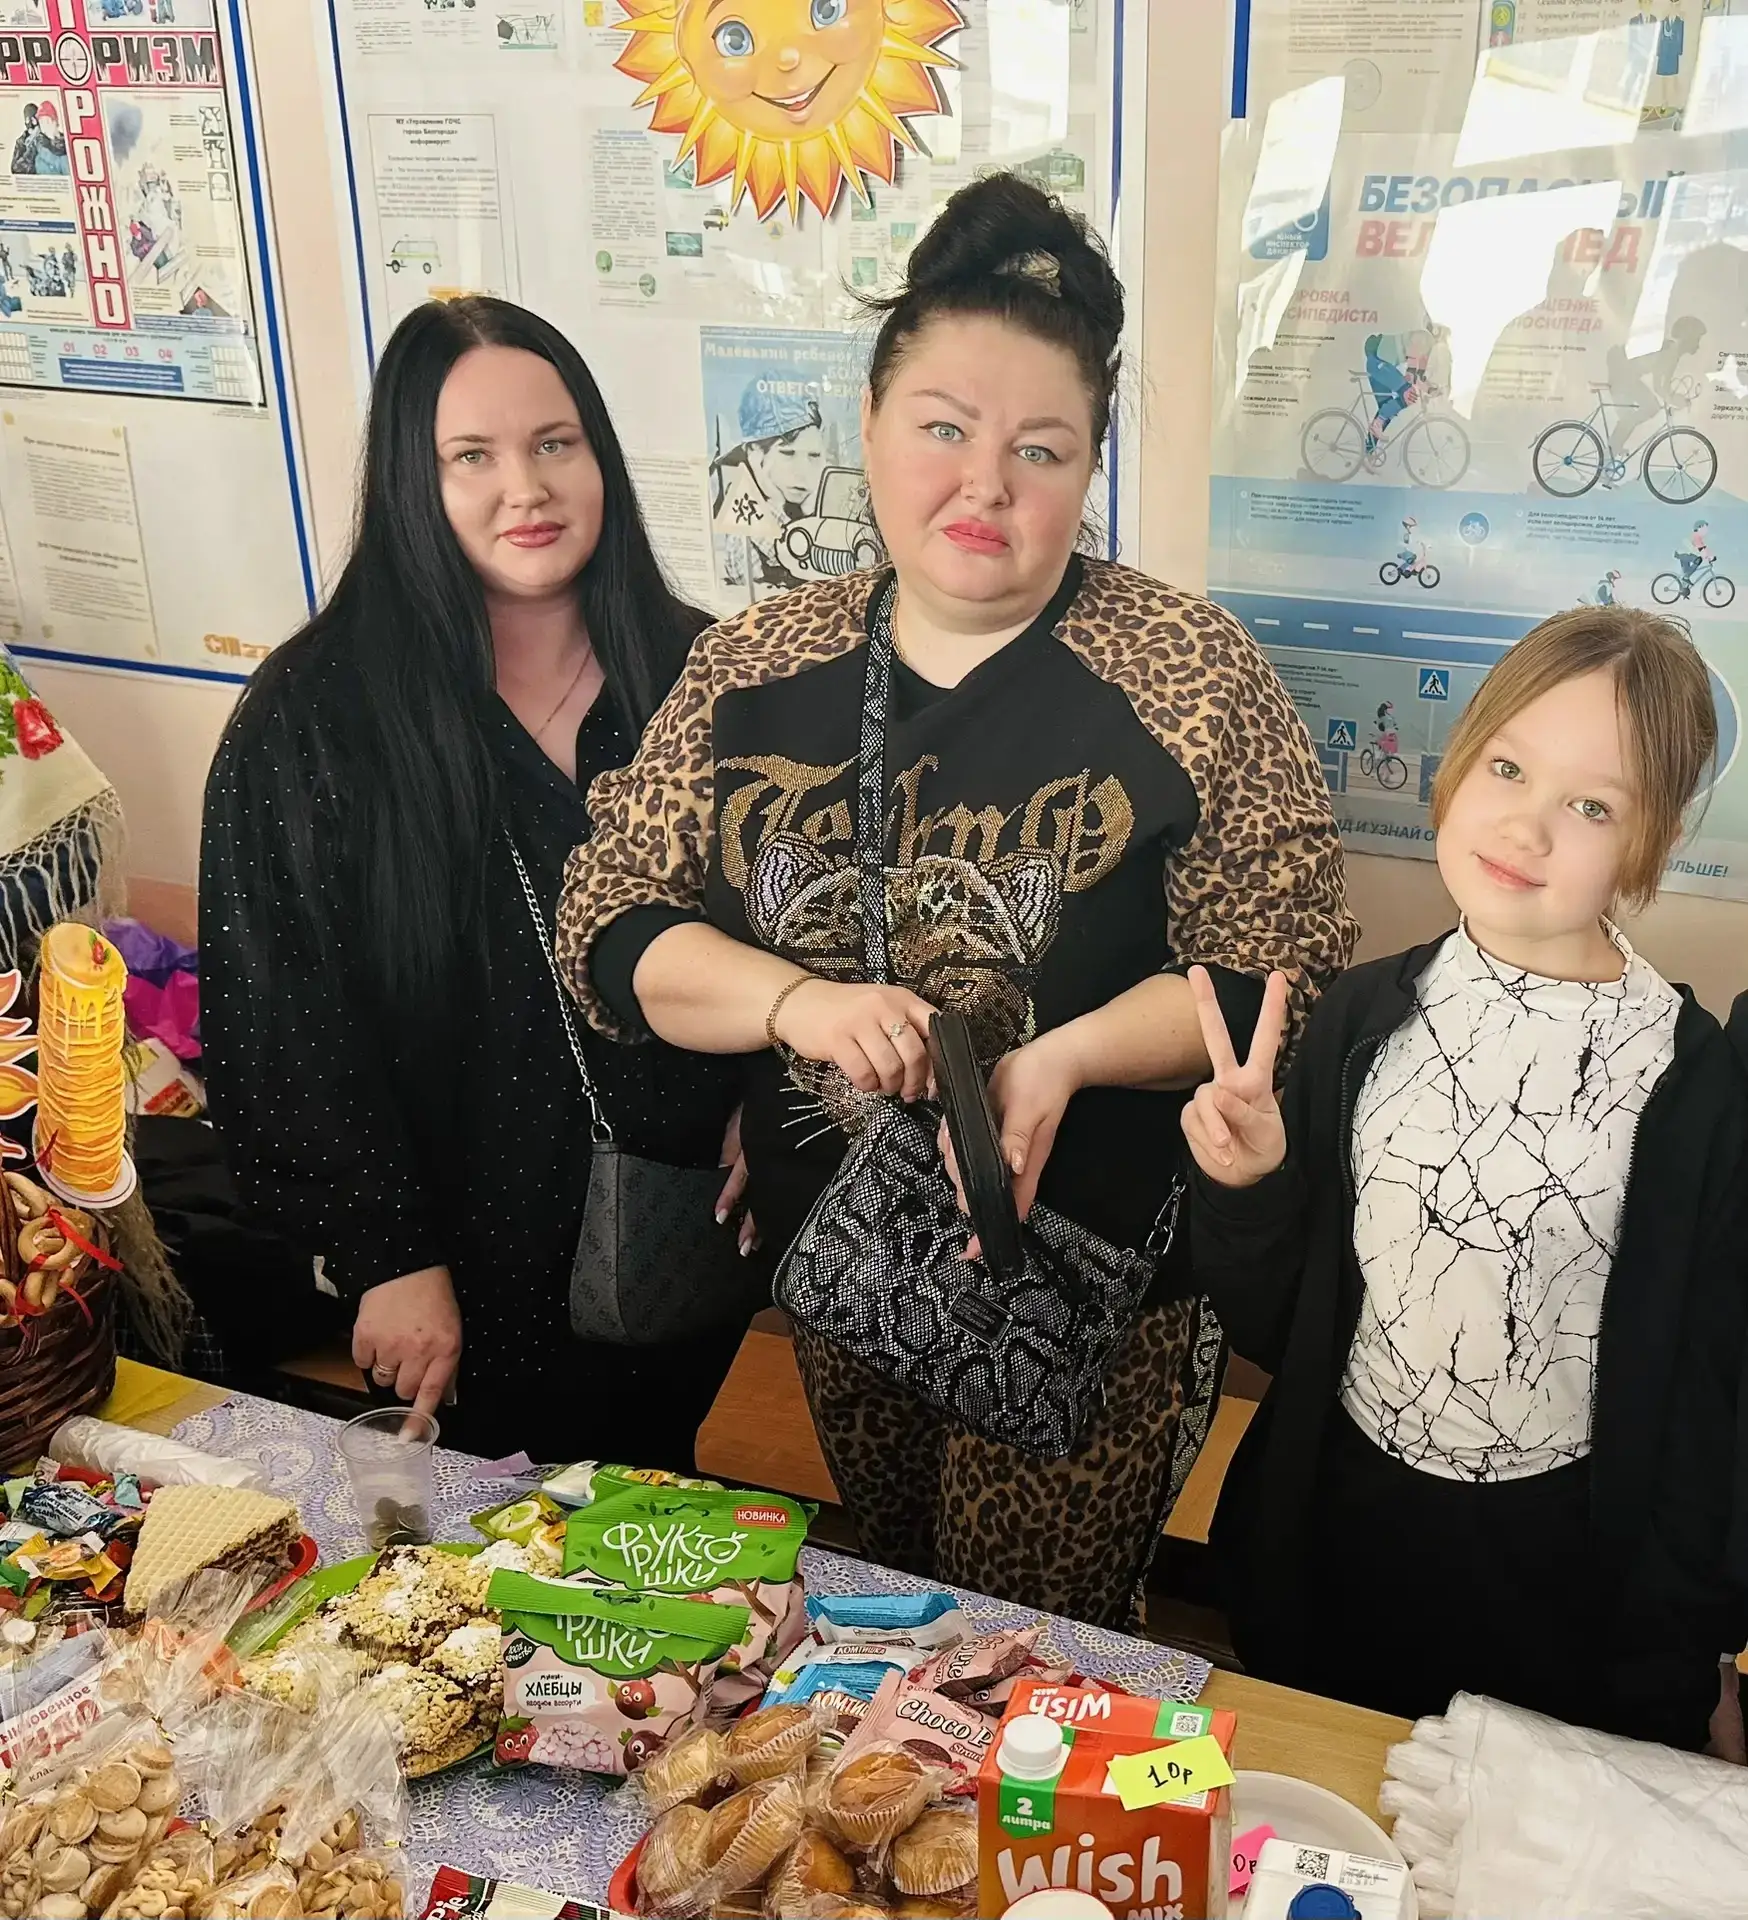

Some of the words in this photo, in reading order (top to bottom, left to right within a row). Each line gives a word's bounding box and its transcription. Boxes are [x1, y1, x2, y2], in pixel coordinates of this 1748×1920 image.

[1369, 823, 1421, 840] УЗНАЙ
[737, 1510, 786, 1524] НОВИНКА
[525, 1681, 583, 1697] ХЛЕБЦЫ
[896, 1698, 971, 1739] Choco
[1016, 1796, 1034, 1816] 2
[1002, 1813, 1051, 1831] литра
[997, 1833, 1183, 1905] Wish
